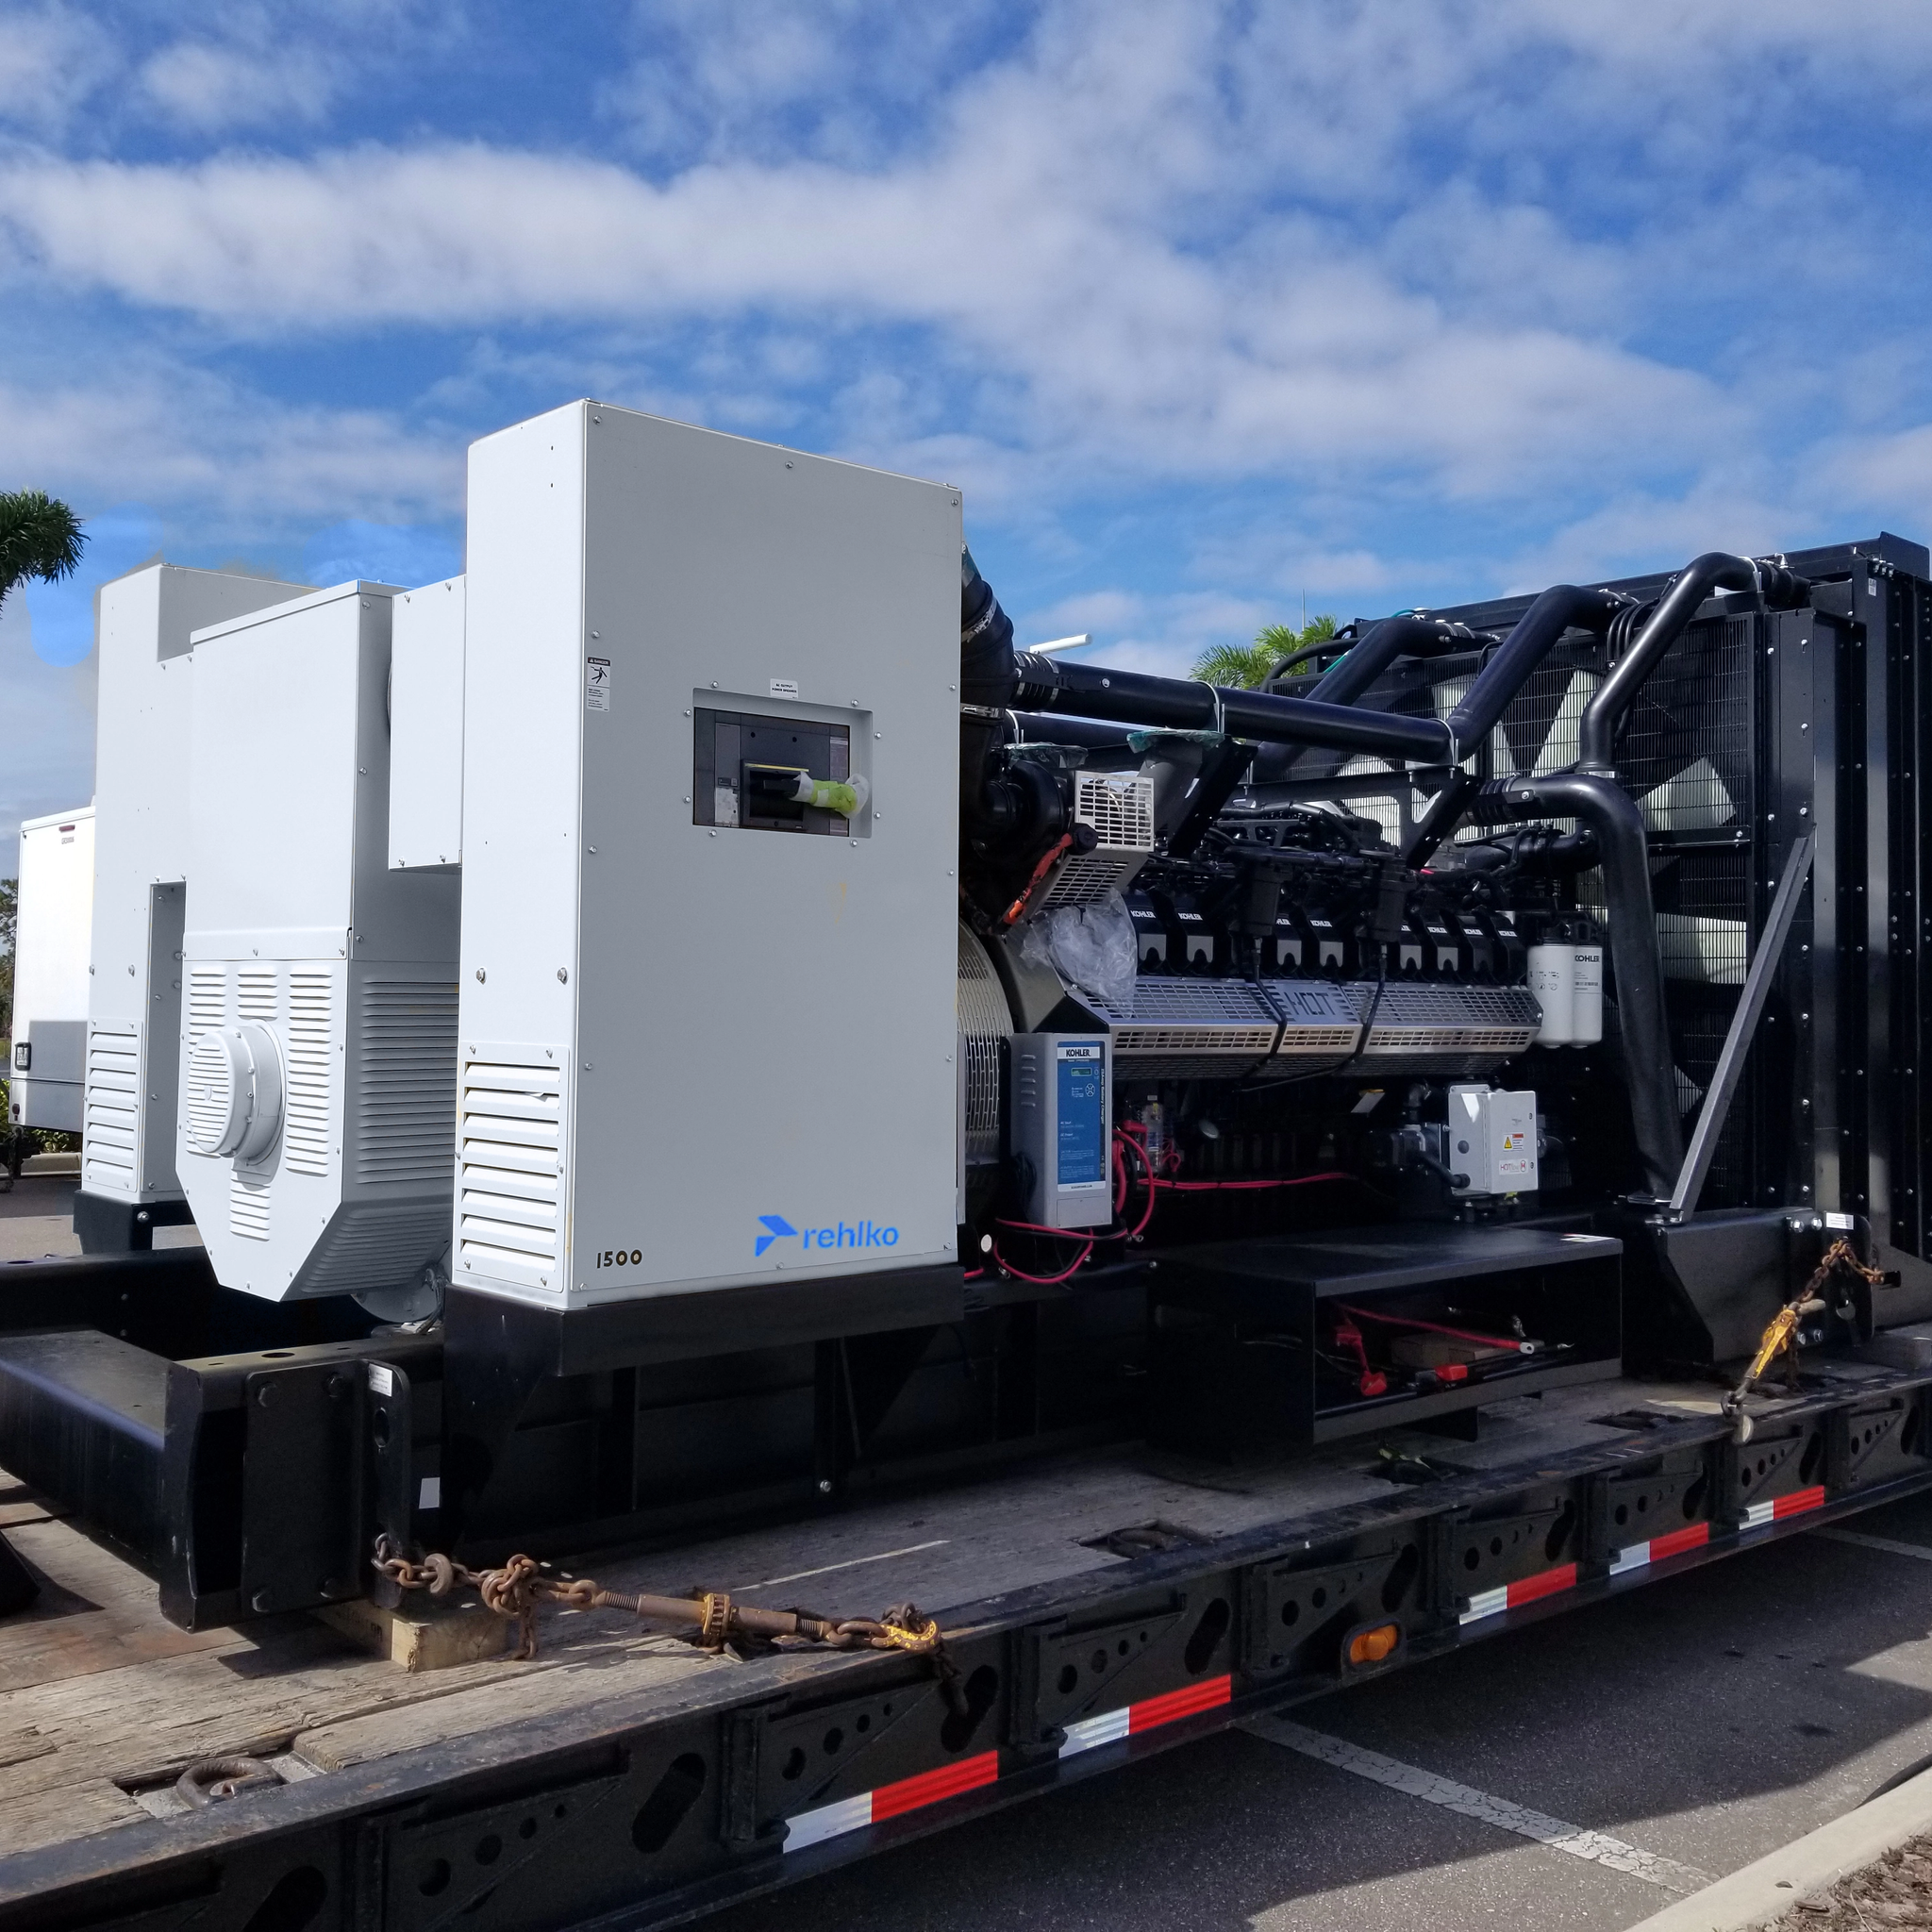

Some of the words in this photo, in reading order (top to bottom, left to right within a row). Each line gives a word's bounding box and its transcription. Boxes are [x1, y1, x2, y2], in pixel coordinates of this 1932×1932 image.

[1284, 992, 1336, 1015] HOT
[803, 1220, 900, 1251] rehlko
[596, 1249, 642, 1269] 1500
